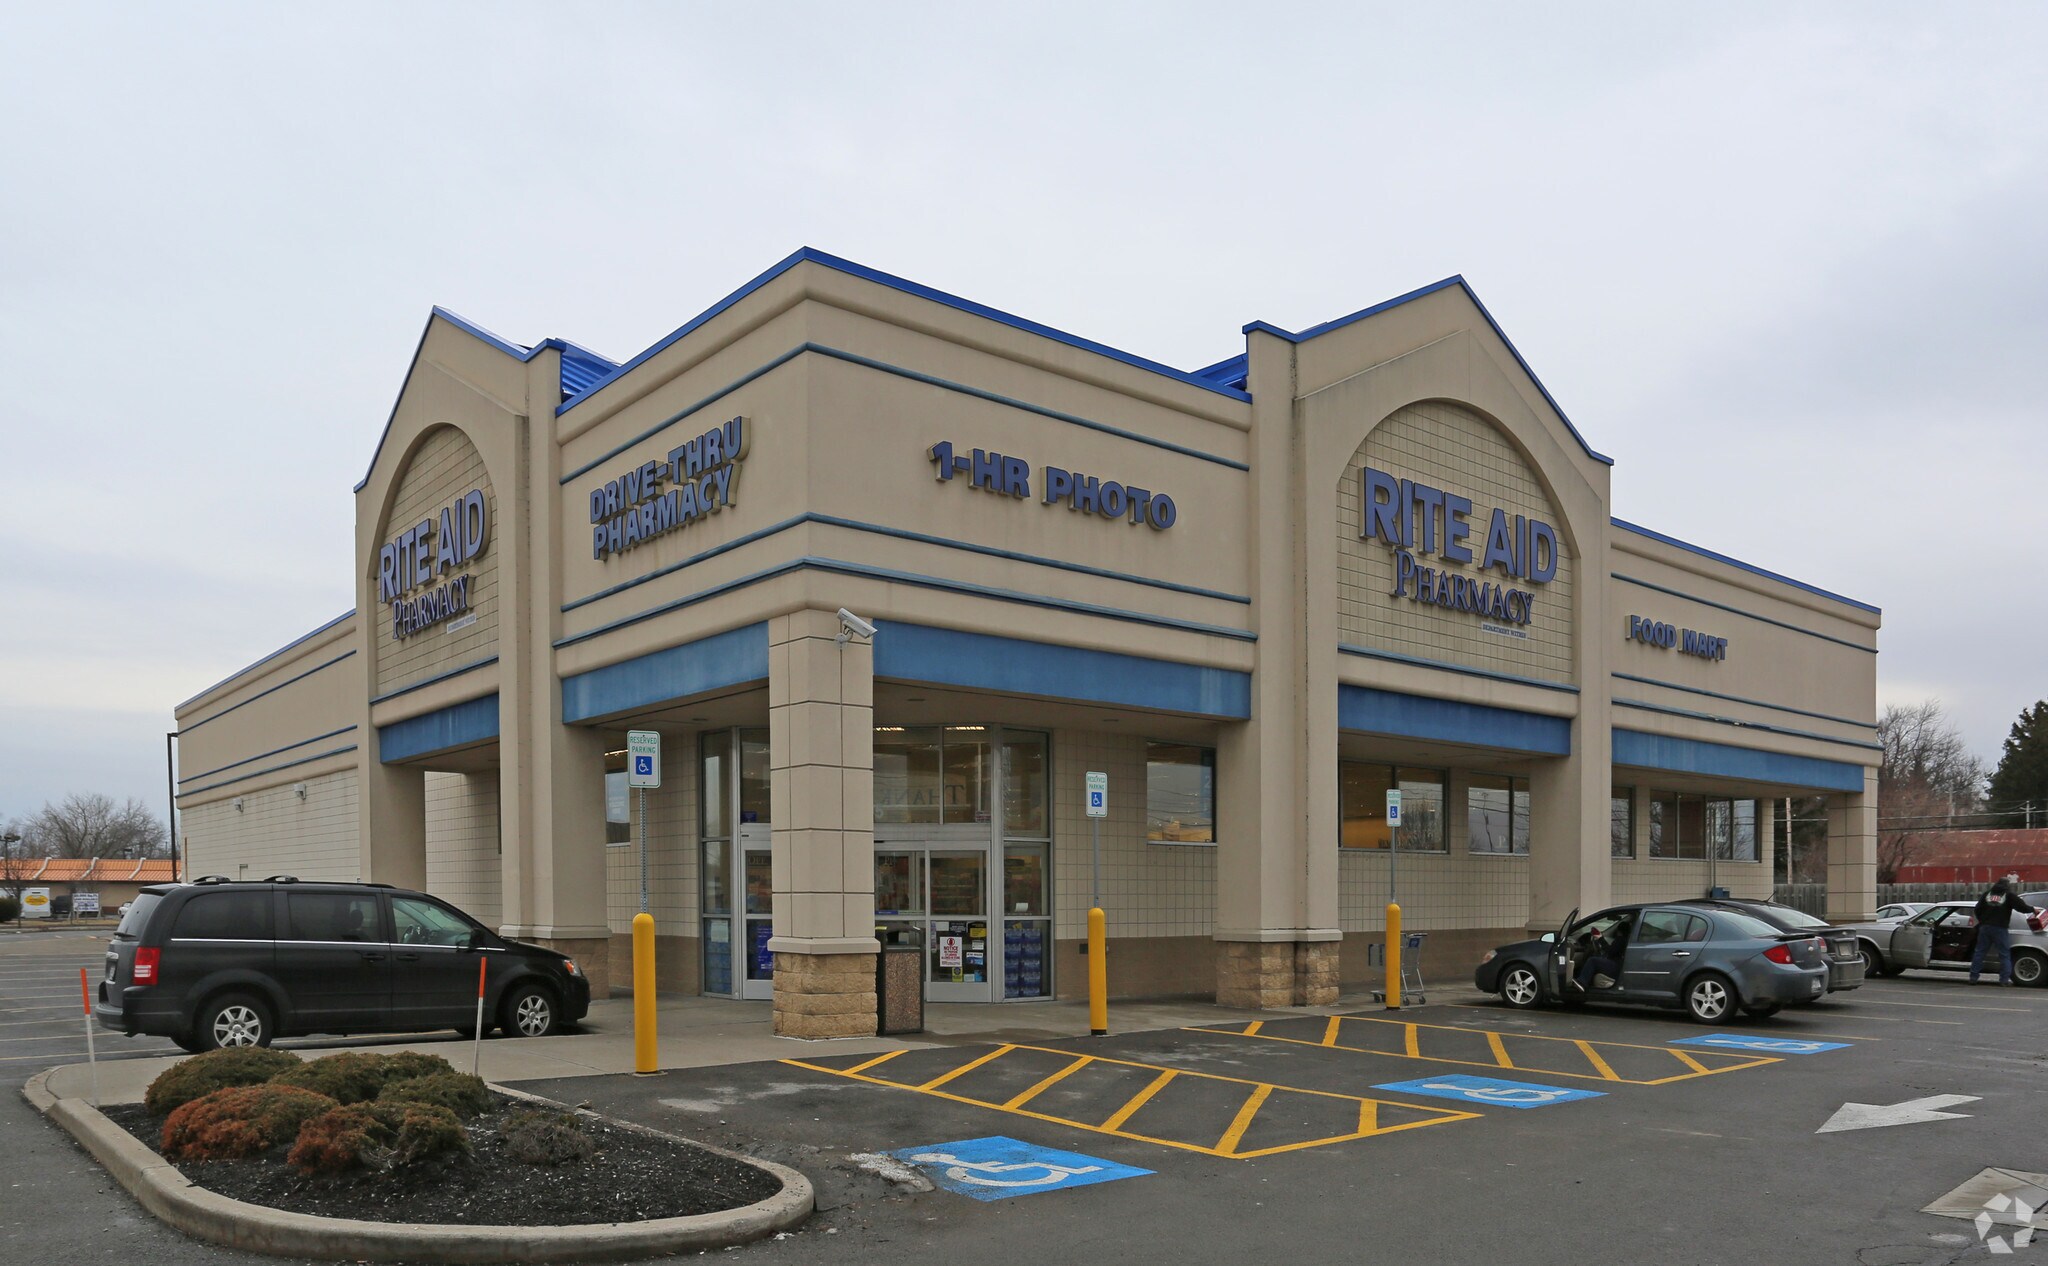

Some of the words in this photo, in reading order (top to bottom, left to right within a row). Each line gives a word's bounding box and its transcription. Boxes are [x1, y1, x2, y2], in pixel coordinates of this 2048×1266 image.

[590, 416, 749, 524] DRIVE-THRU
[594, 464, 740, 561] PHARMACY
[928, 441, 1030, 498] 1-HR
[1041, 466, 1177, 530] PHOTO
[380, 519, 436, 603] RITE
[437, 489, 490, 575] AID
[1360, 467, 1472, 564] RITE
[1480, 508, 1558, 584] AID
[1625, 615, 1677, 648] FOOD
[1678, 628, 1728, 661] MART
[630, 736, 658, 745] RESERVED
[632, 746, 656, 754] PARKING
